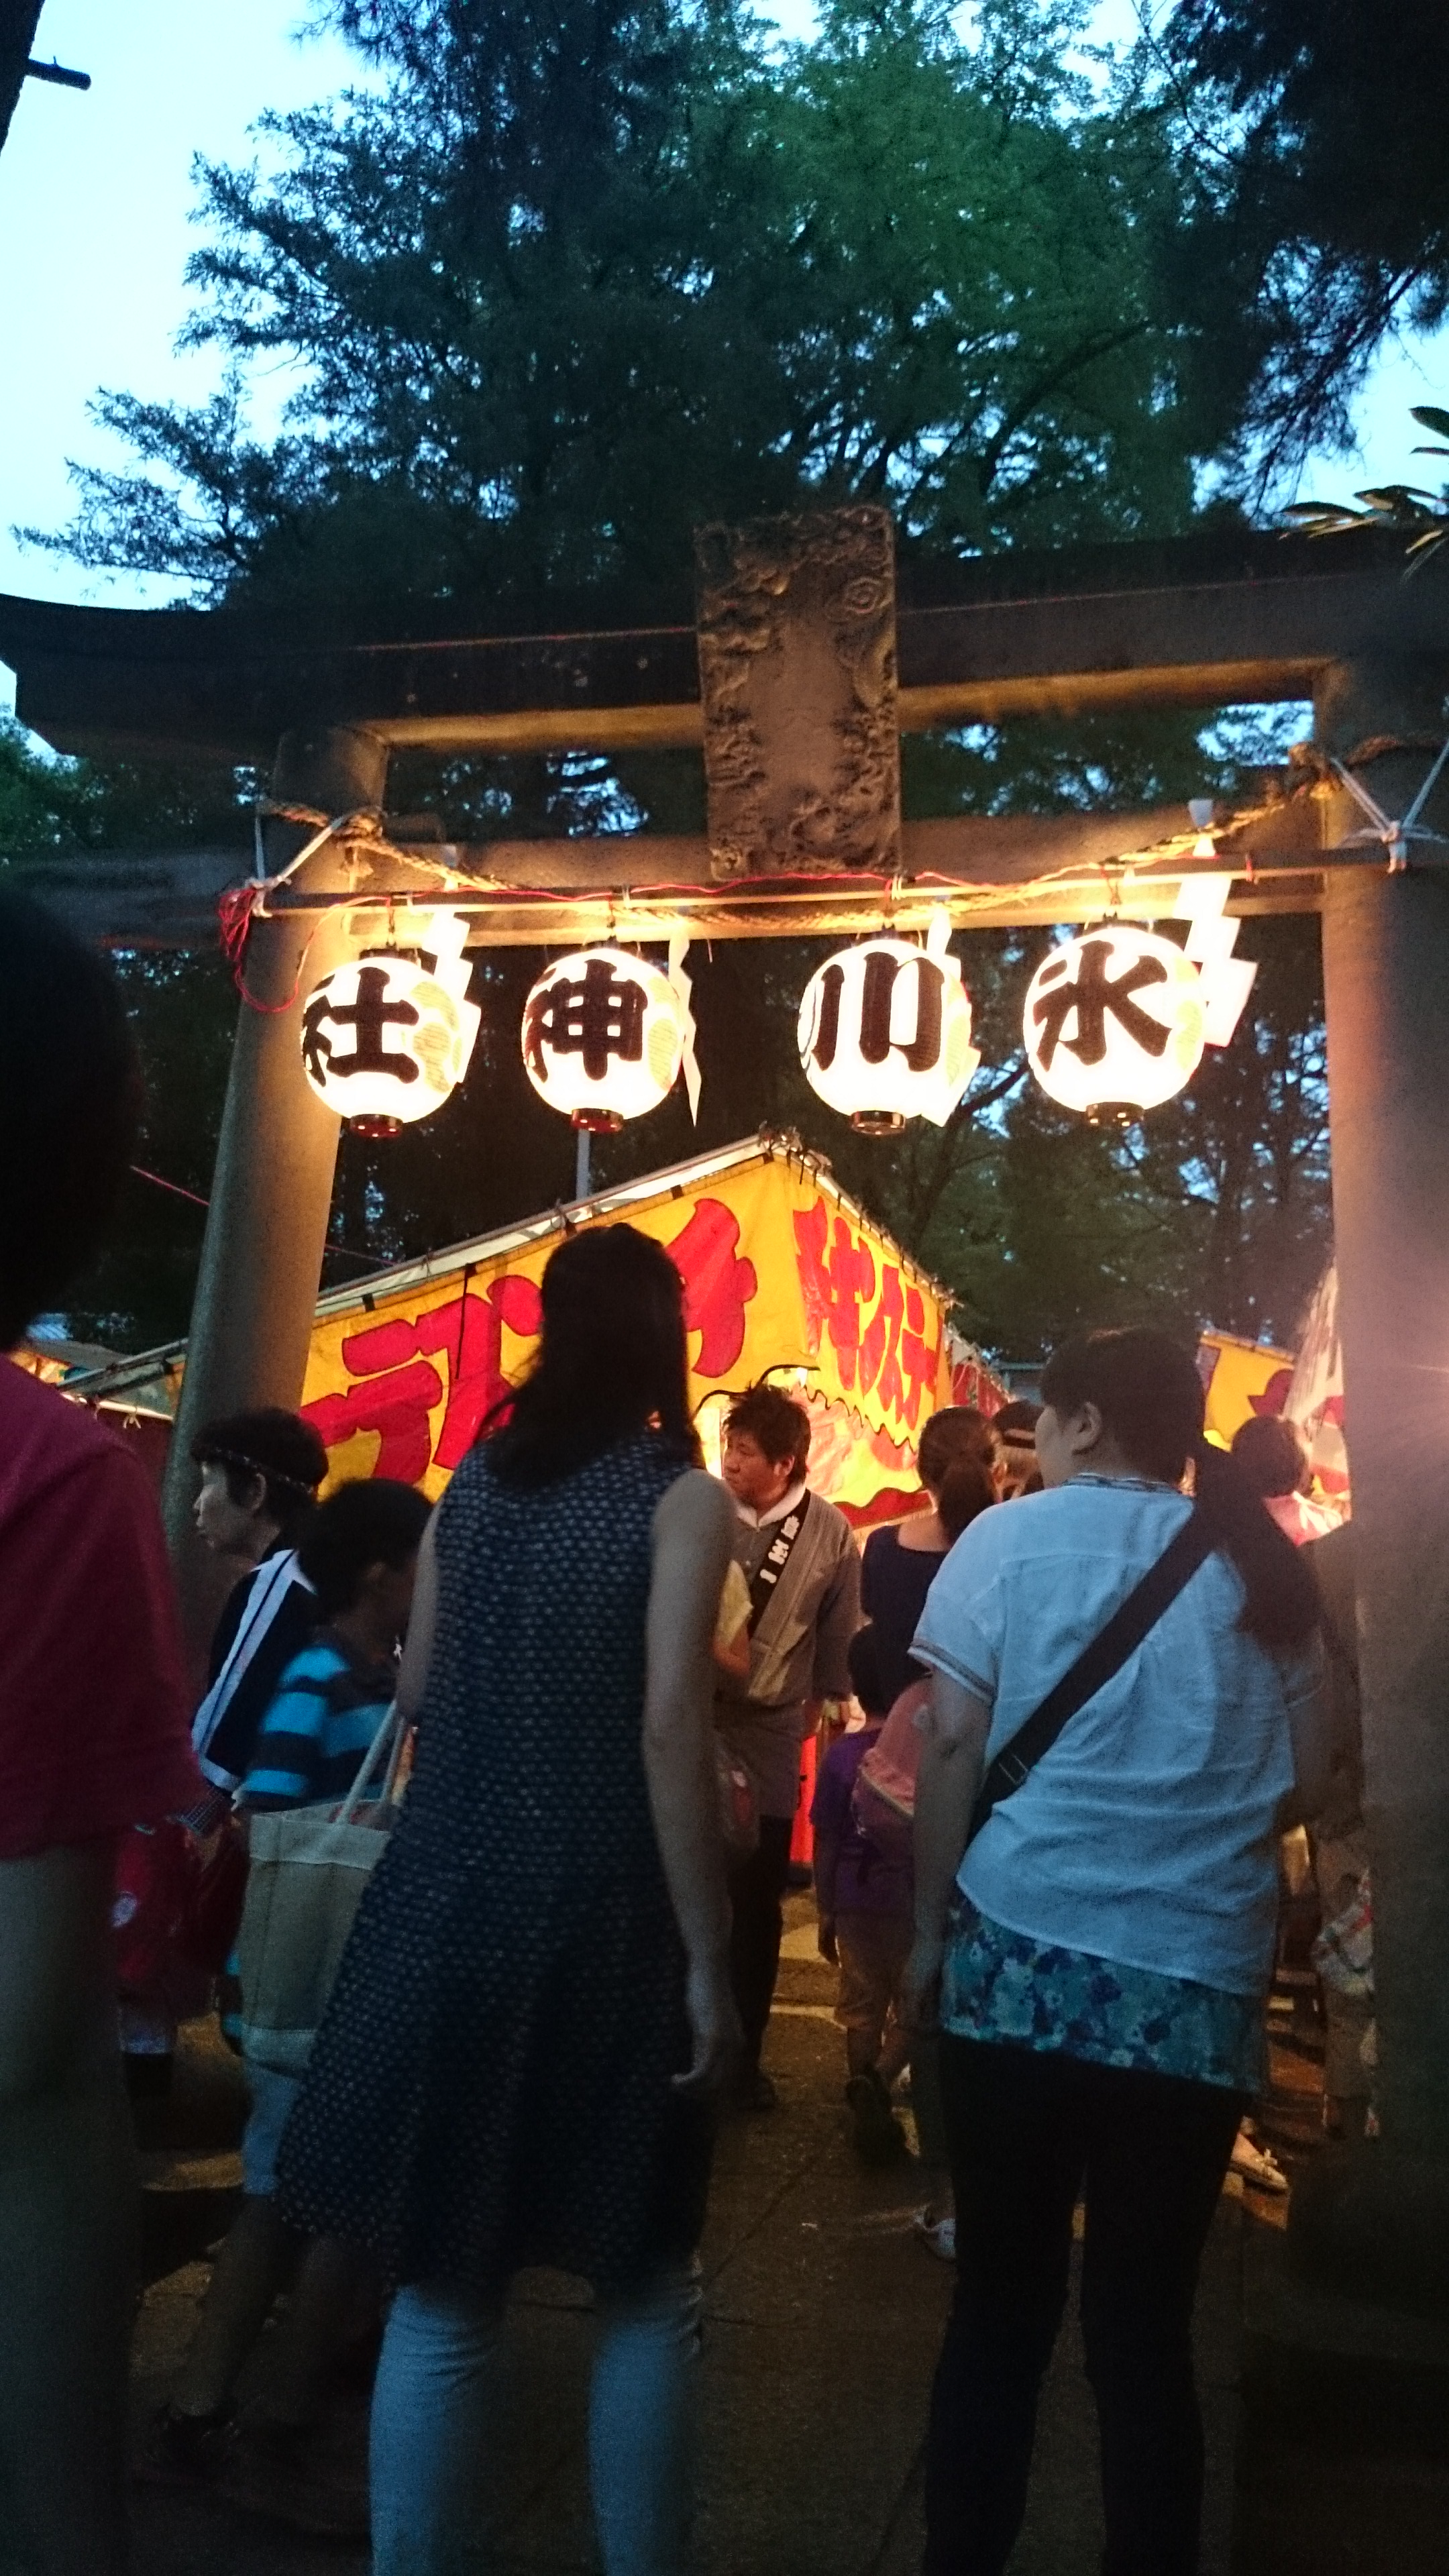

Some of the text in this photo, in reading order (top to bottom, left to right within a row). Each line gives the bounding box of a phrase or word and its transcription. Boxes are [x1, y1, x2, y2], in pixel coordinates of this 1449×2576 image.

[302, 966, 420, 1087] 社
[523, 959, 648, 1083] 神
[813, 951, 945, 1072] 川
[1033, 940, 1173, 1072] 氷
